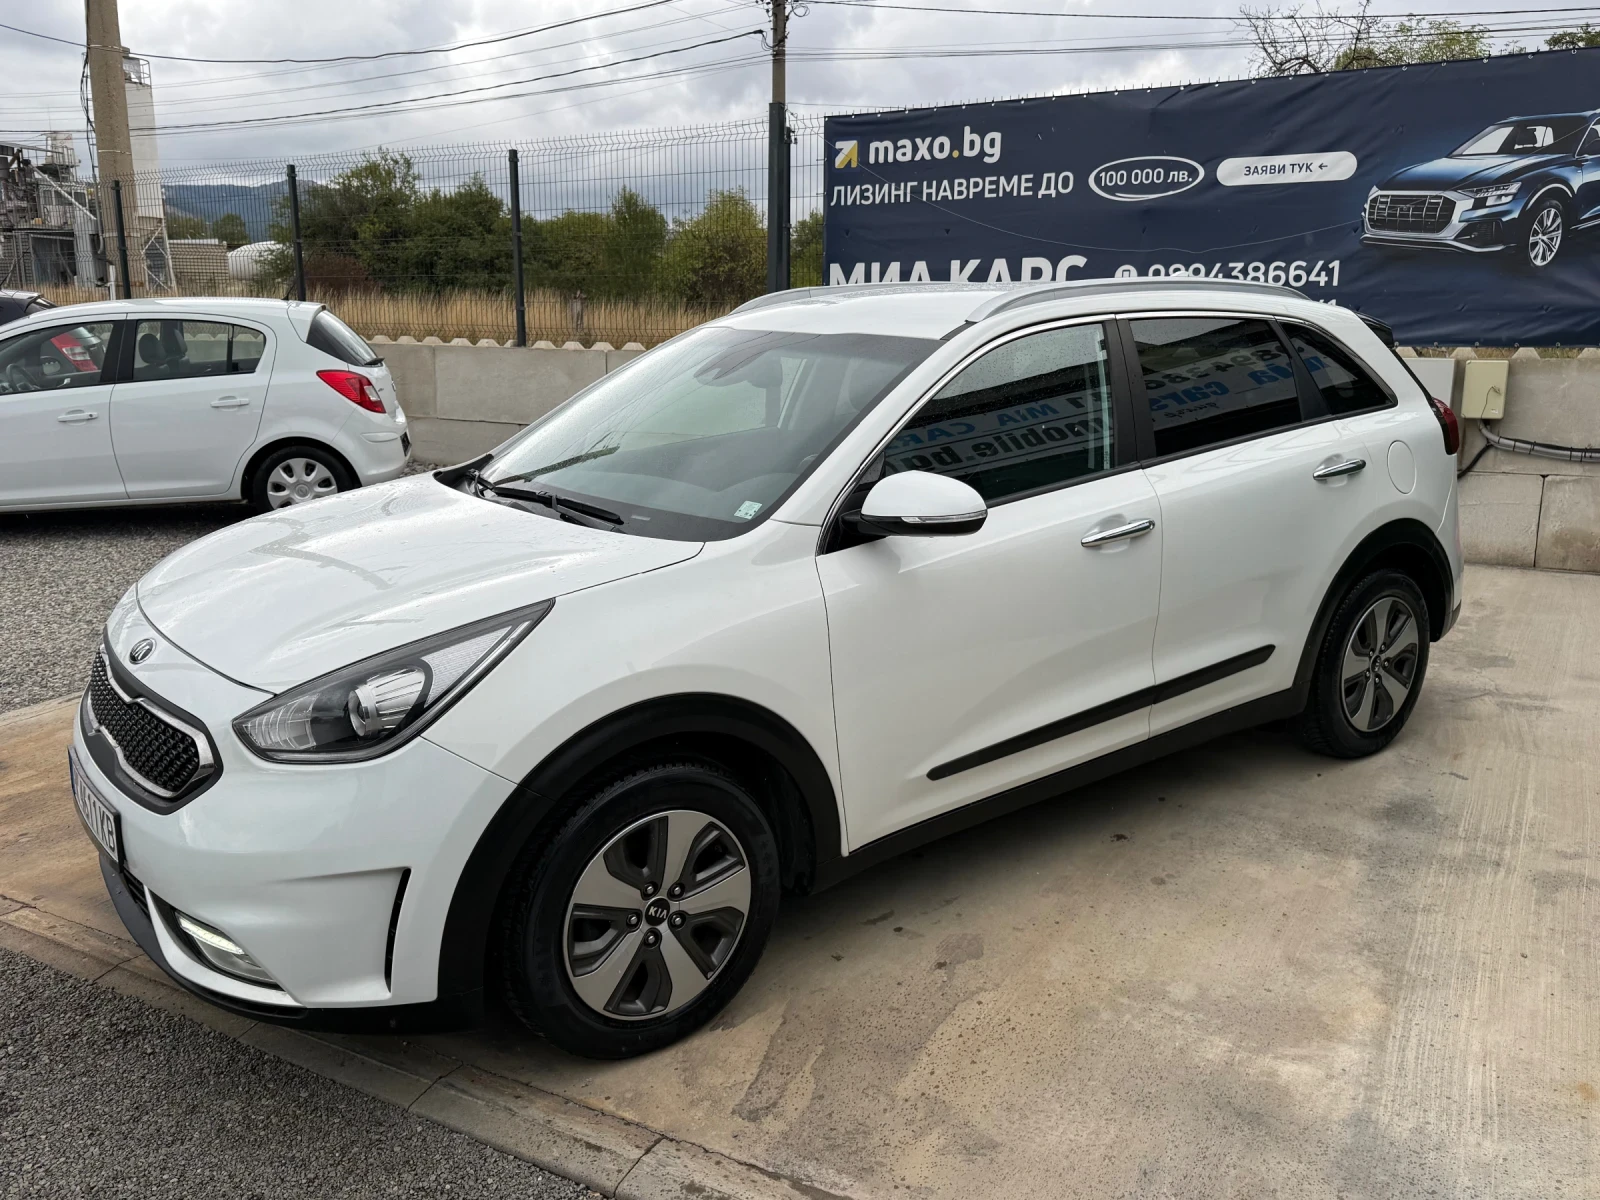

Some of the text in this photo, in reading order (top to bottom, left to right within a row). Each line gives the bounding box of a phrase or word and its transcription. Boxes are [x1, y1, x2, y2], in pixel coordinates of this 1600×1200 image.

[868, 126, 1002, 164] maxo.bg
[1099, 168, 1193, 187] 100 000 лв.
[1243, 162, 1313, 177] ЗАЯВИ ТУК
[830, 171, 1074, 207] ЛИЗИНГ НАВРЕМЕ ДО
[648, 905, 668, 919] KIA
